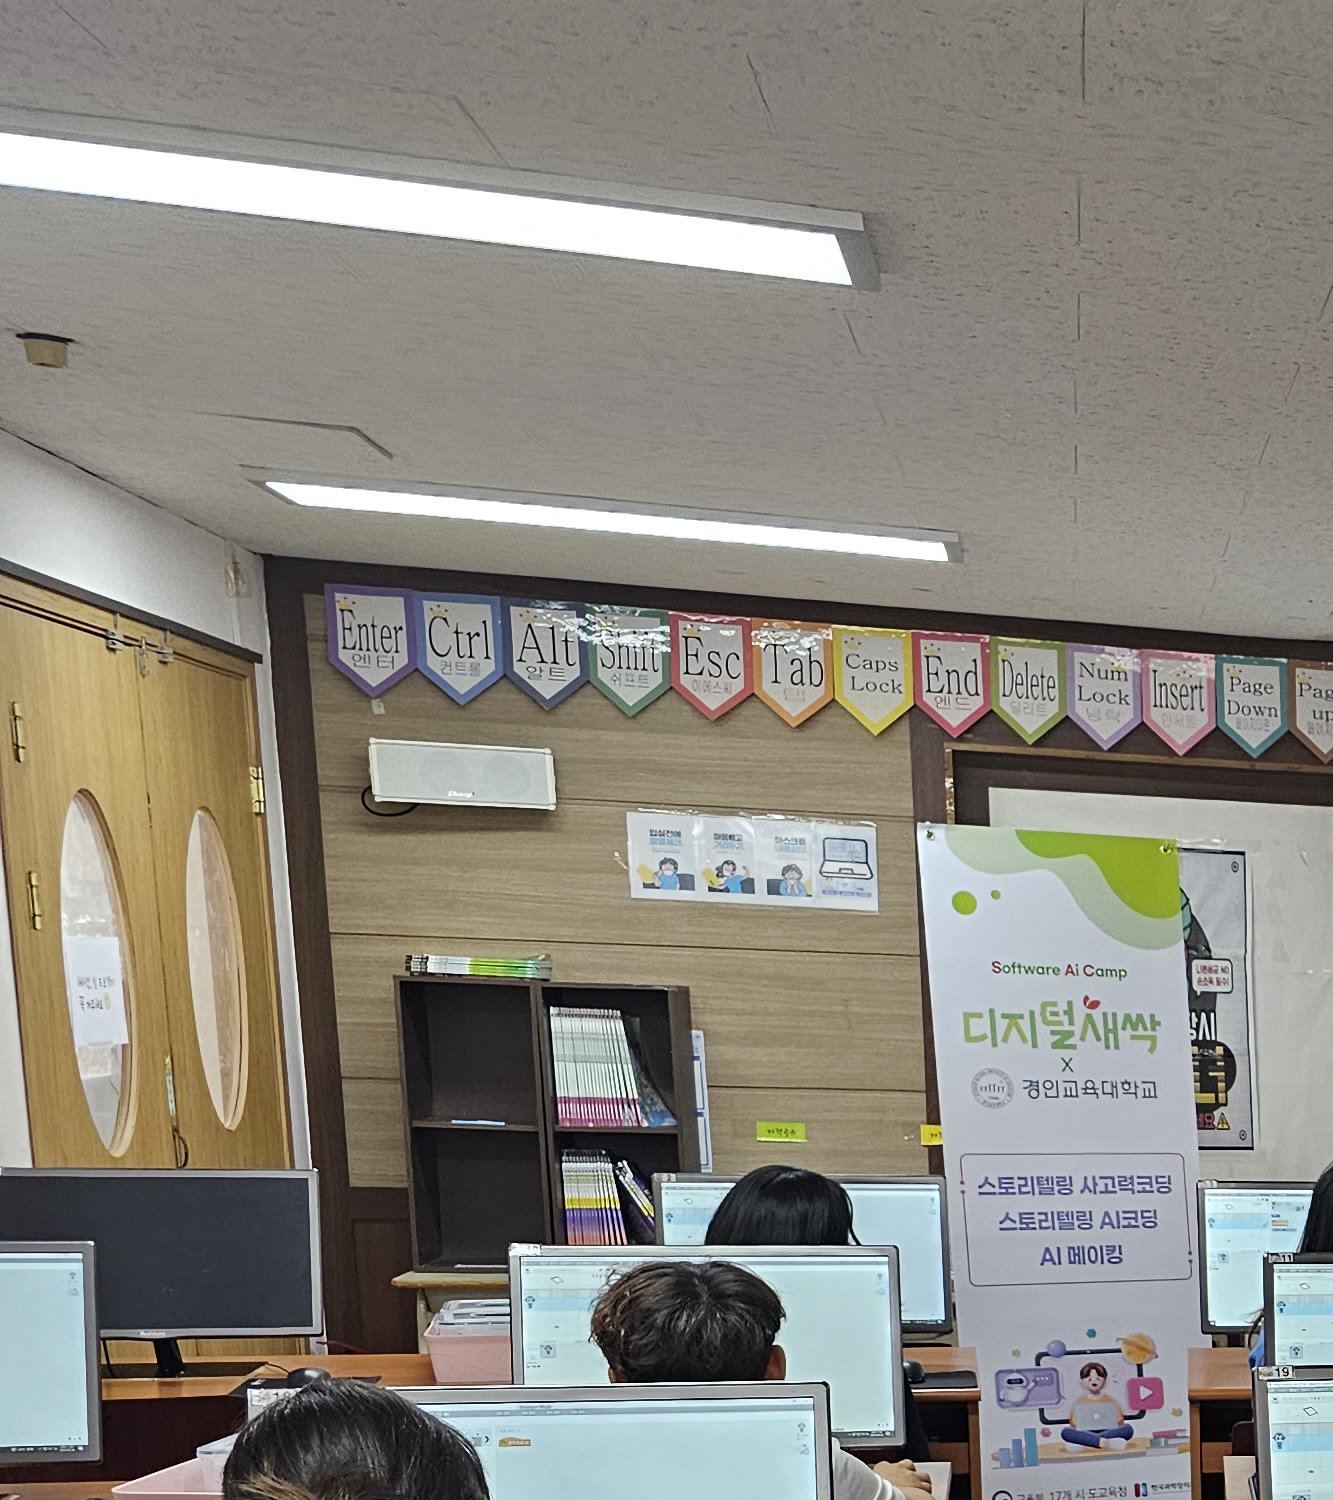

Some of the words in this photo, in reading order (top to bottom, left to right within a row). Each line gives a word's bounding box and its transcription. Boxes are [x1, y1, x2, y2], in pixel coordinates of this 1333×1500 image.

[340, 609, 403, 654] Enter
[428, 617, 493, 661] Ctrl
[517, 622, 577, 667] Alt
[352, 654, 394, 670] 엔터
[440, 660, 481, 677] 컨트롤
[682, 636, 741, 680] Esc
[765, 643, 824, 688] Tab
[845, 653, 900, 676] Caps
[526, 665, 566, 683] 알트
[609, 672, 650, 688] 쉬프트
[924, 656, 981, 698] End
[1002, 658, 1057, 703] Delete
[1079, 660, 1129, 684] Num
[850, 676, 904, 695] Lock
[1078, 684, 1130, 707] Lock
[1152, 668, 1206, 712] Insert
[1229, 676, 1275, 698] Page
[1226, 700, 1280, 720] Down
[991, 961, 1061, 977] Software
[1064, 963, 1080, 977] Ai
[1083, 964, 1128, 981] Camp
[963, 1000, 1162, 1055] 디지털새싹
[1021, 1079, 1158, 1100] 경인교육대학교
[977, 1175, 1074, 1197] 스토리텔링
[1080, 1174, 1173, 1195] 사고력코딩
[999, 1210, 1093, 1233] 스토리텔링
[1099, 1209, 1159, 1230] AI코딩
[1040, 1247, 1061, 1266] AI
[1067, 1244, 1124, 1266] 메이킹
[1282, 1254, 1291, 1262] 11
[1275, 1367, 1288, 1377] 19
